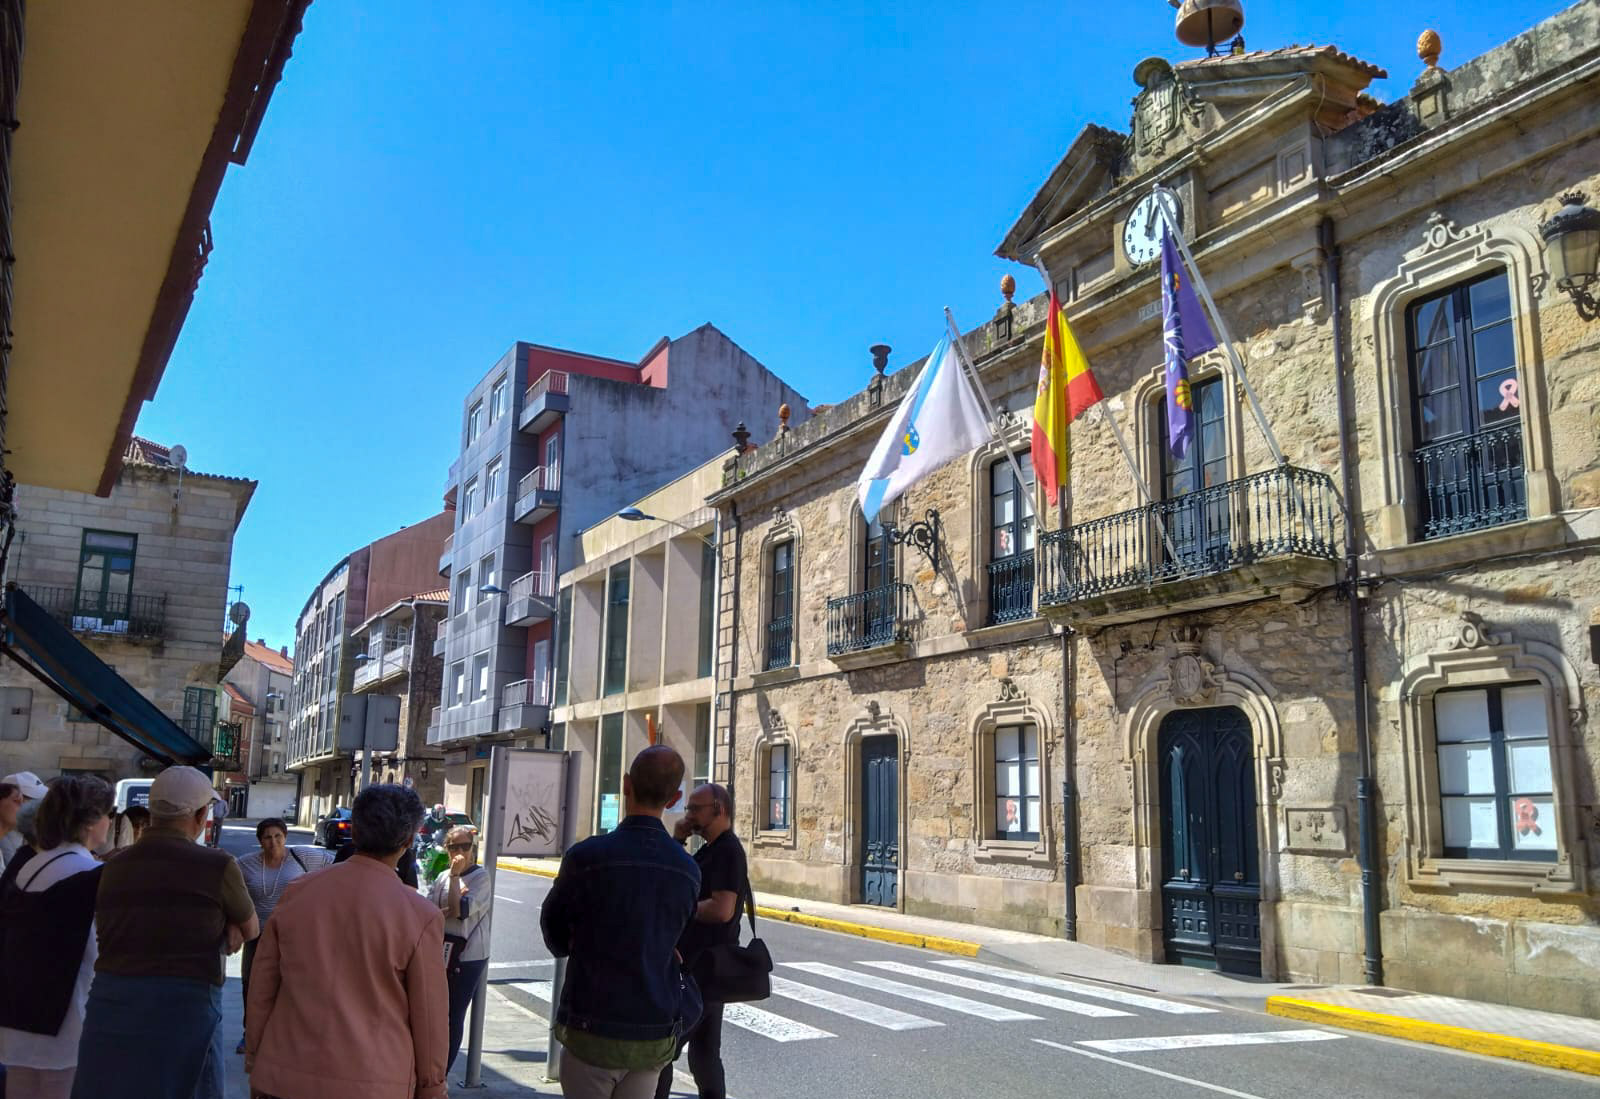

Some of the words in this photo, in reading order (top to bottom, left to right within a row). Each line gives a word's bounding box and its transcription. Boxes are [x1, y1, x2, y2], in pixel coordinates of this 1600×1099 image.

[1137, 207, 1142, 217] 11
[1130, 219, 1136, 229] 10
[1127, 234, 1132, 242] 9
[1139, 249, 1144, 258] 7
[1149, 248, 1154, 257] 6
